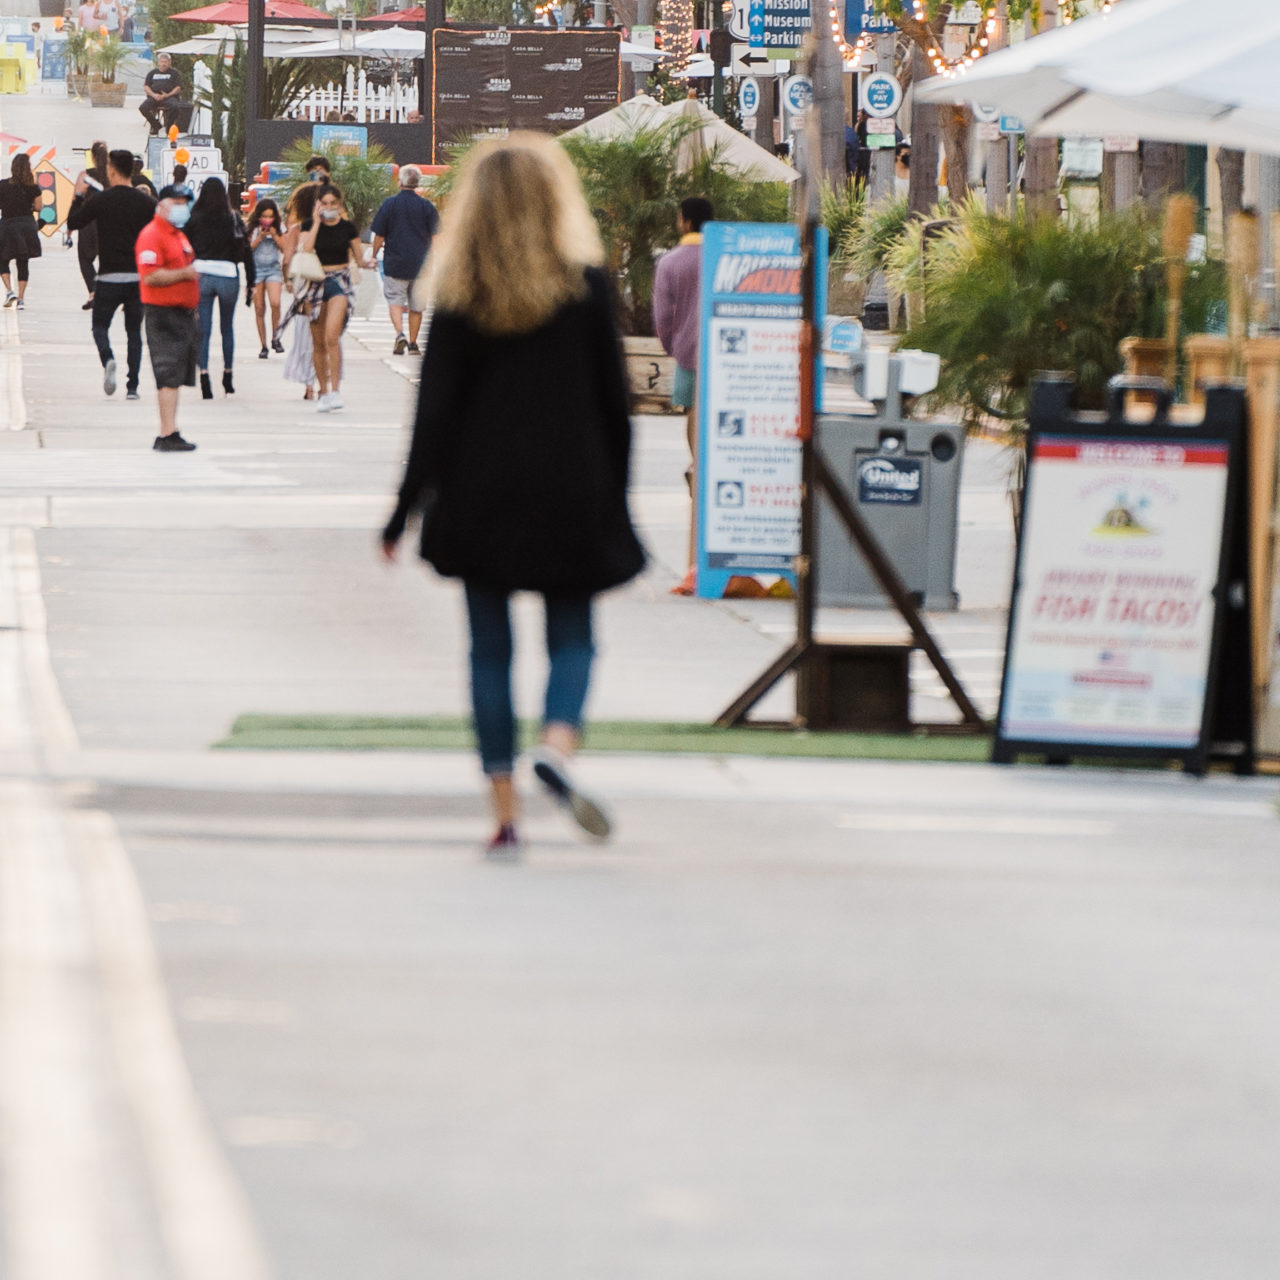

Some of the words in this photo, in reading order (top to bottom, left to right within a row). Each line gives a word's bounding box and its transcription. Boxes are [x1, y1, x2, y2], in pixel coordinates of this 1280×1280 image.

[738, 8, 743, 30] 1
[764, 14, 812, 27] Museum
[764, 30, 804, 45] Parkin
[871, 83, 891, 91] PARK
[867, 469, 920, 484] United
[1032, 595, 1098, 621] FISH
